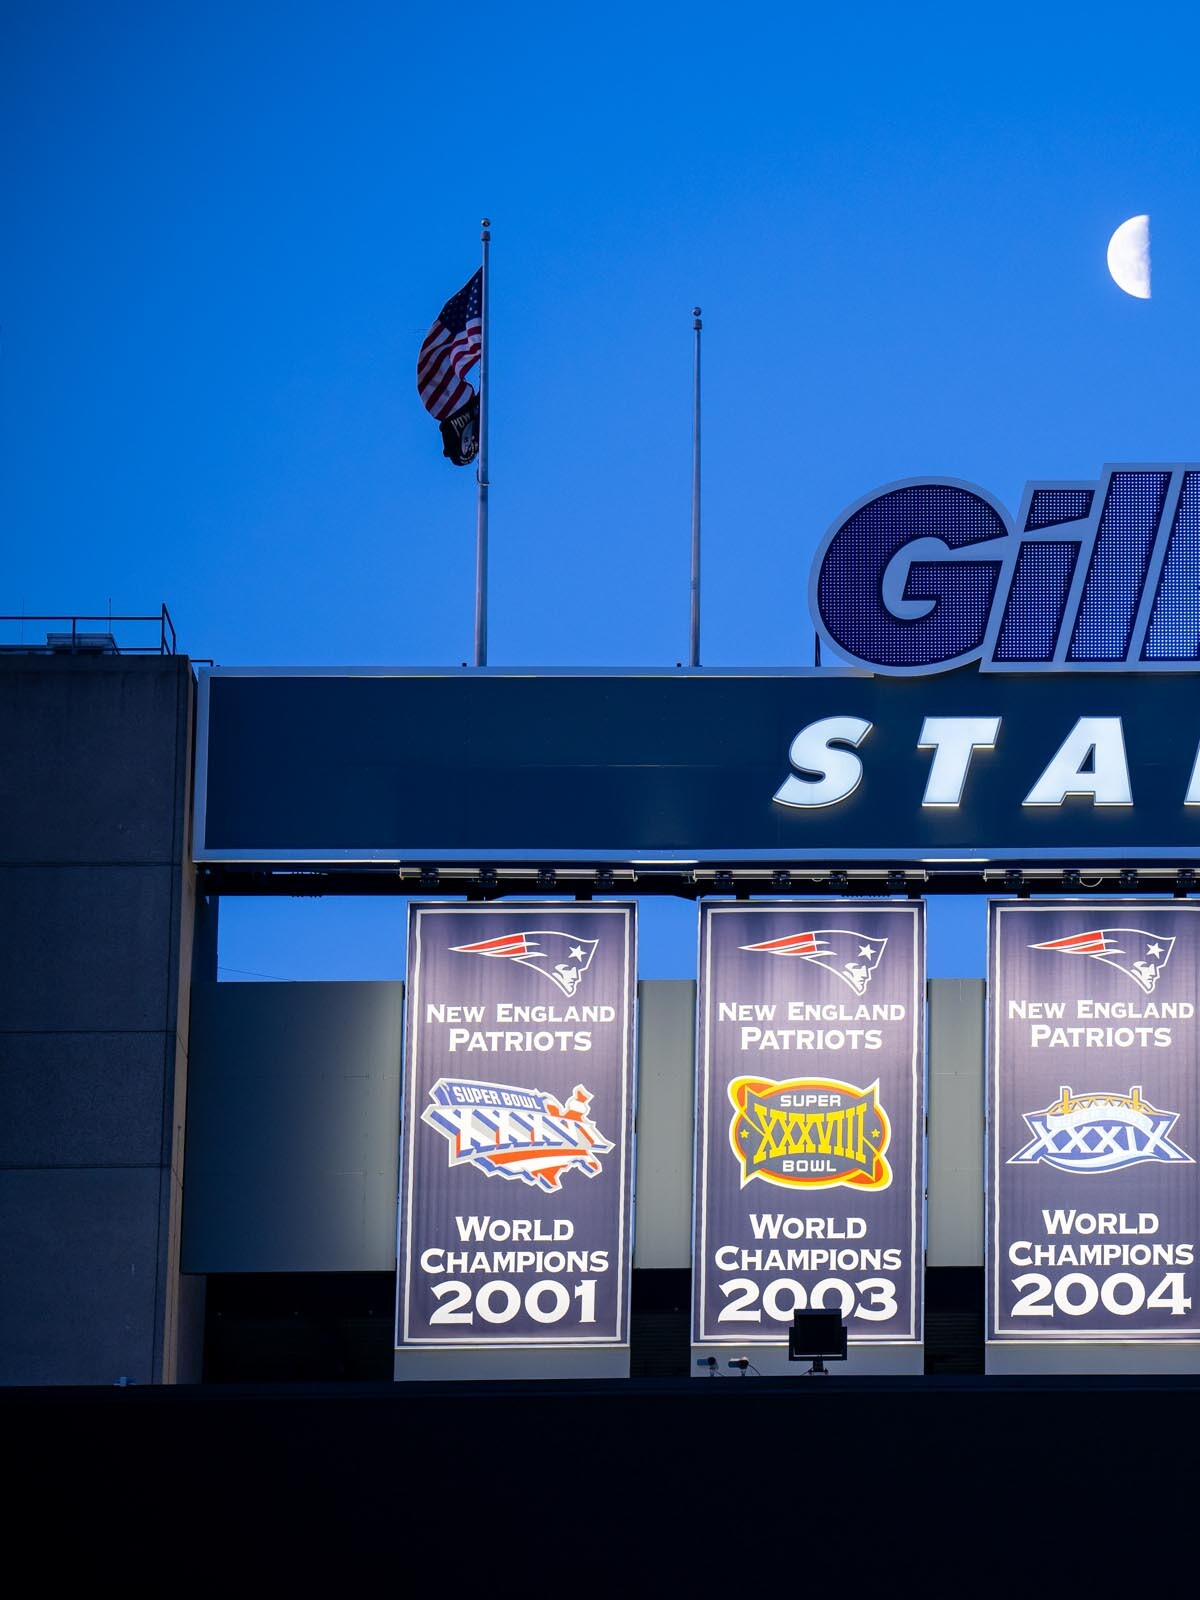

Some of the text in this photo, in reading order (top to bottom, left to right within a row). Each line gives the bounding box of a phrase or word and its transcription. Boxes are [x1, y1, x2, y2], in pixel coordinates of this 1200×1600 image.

[426, 1003, 616, 1024] NEW ENGLAND
[718, 1001, 906, 1022] NEW ENGLAND
[1008, 999, 1195, 1020] NEW ENGLAND
[449, 1028, 592, 1052] PATRIOTS
[741, 1026, 883, 1050] PATRIOTS
[1031, 1024, 1172, 1048] PATRIOTS
[452, 1085, 541, 1110] SUPER BOWL
[780, 1094, 841, 1107] SUPER
[427, 1107, 607, 1158] XXXVI
[753, 1102, 867, 1164] XXXVIII
[1018, 1120, 1185, 1160] XXXIX
[782, 1159, 837, 1172] BOWL
[455, 1216, 574, 1242] WORLD
[749, 1213, 867, 1239] WORLD
[1042, 1209, 1159, 1235] WORLD
[420, 1248, 609, 1274] CHAMPIONS
[715, 1245, 902, 1271] CHAMPIONS
[1008, 1240, 1194, 1266] CHAMPIONS
[429, 1279, 596, 1325] 2001
[717, 1277, 898, 1322] 2003
[1011, 1272, 1192, 1317] 2004
